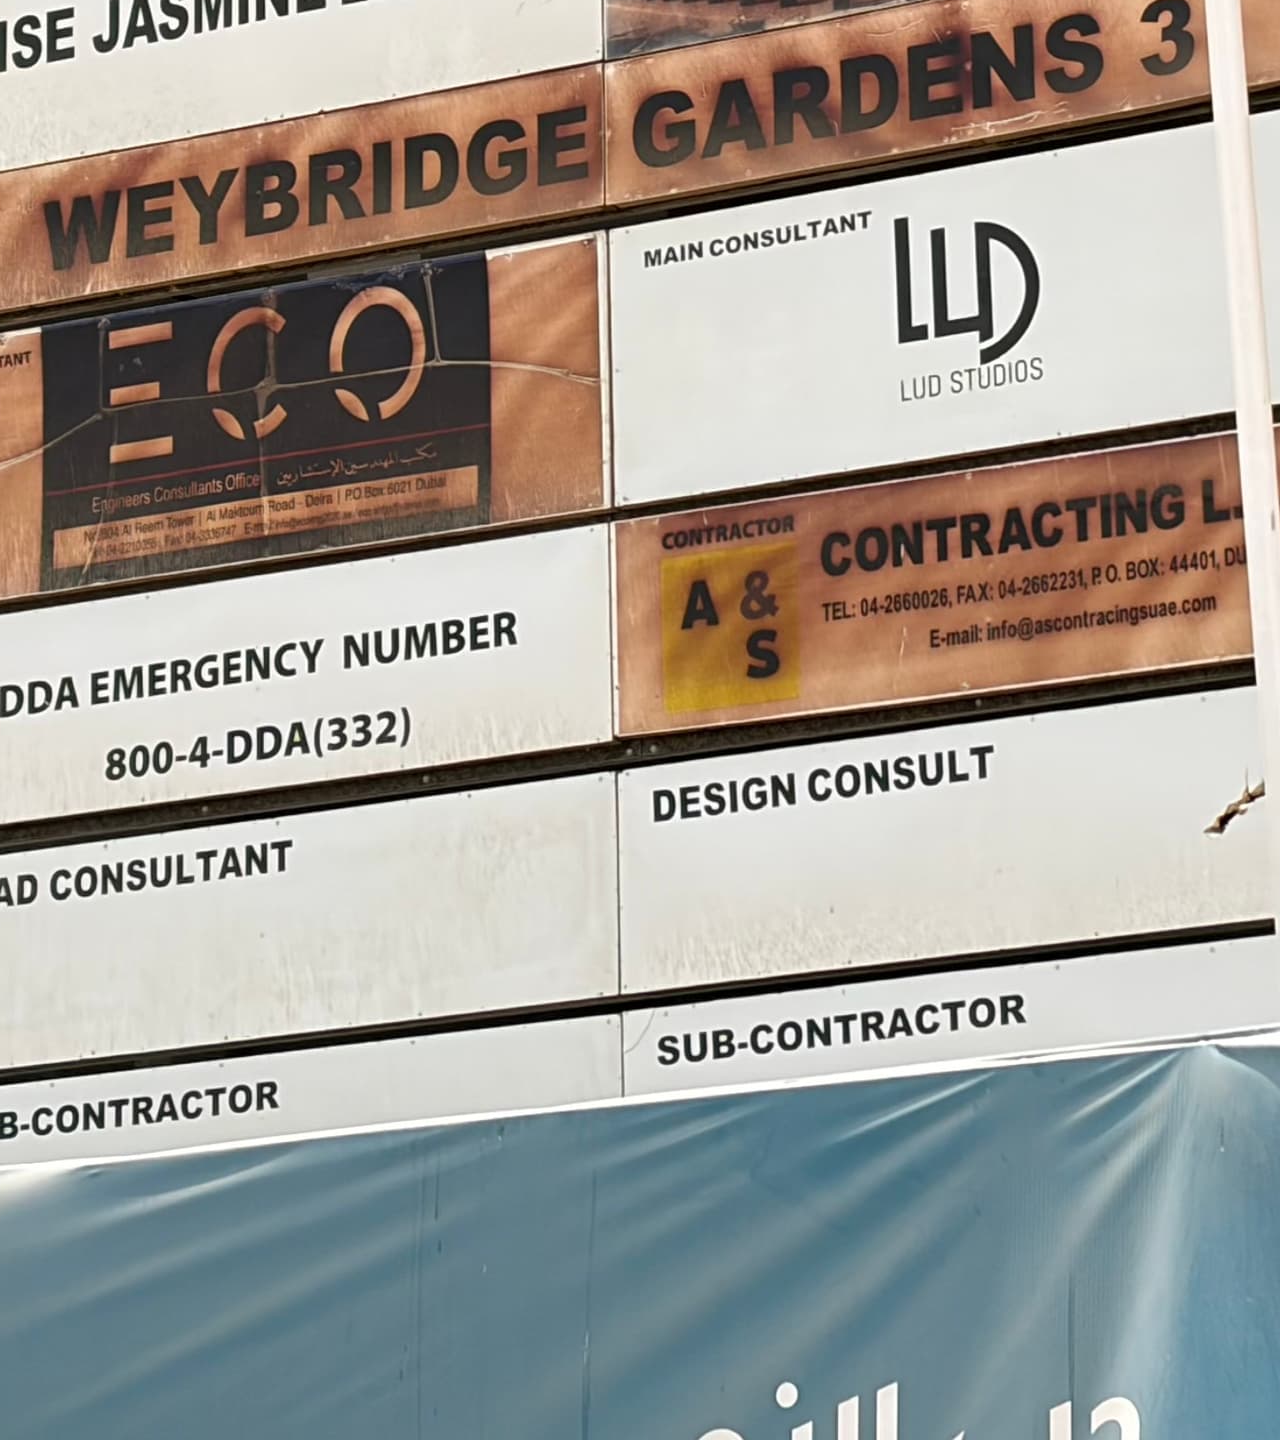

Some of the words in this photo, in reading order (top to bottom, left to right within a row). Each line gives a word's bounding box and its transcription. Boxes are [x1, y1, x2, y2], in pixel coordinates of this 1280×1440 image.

[42, 104, 590, 273] WEYBRIDGE
[629, 10, 1107, 170] GARDENS
[644, 240, 705, 269] MAIN
[708, 210, 873, 259] CONSULTANT
[107, 286, 426, 465] ECO
[900, 372, 942, 403] LUD
[949, 356, 1045, 394] STUDIOS
[91, 490, 151, 514] Engineers
[154, 477, 224, 504] Consultants
[225, 471, 262, 492] Office
[661, 514, 795, 551] CONTRACTOR
[821, 484, 1186, 577] CONTRACTING
[680, 581, 720, 631] A
[740, 571, 780, 621] &
[821, 599, 857, 623] TEL:
[860, 587, 954, 618] 04-2660026,
[956, 580, 995, 605] FAX:
[998, 569, 1088, 601] 04-2662231,
[1126, 554, 1166, 582] BOX:
[1169, 548, 1220, 575] 44401,
[90, 638, 325, 706] EMERGENCY
[342, 610, 518, 668] NUMBER
[745, 629, 780, 679] S
[929, 624, 984, 649] E-mail:
[104, 707, 412, 782] 800-4-DDA(332)
[652, 772, 797, 822] DESIGN
[806, 744, 996, 804] CONSULT
[50, 840, 294, 901] CONSULTANT
[656, 993, 1027, 1067] SUB-CONTRACTOR
